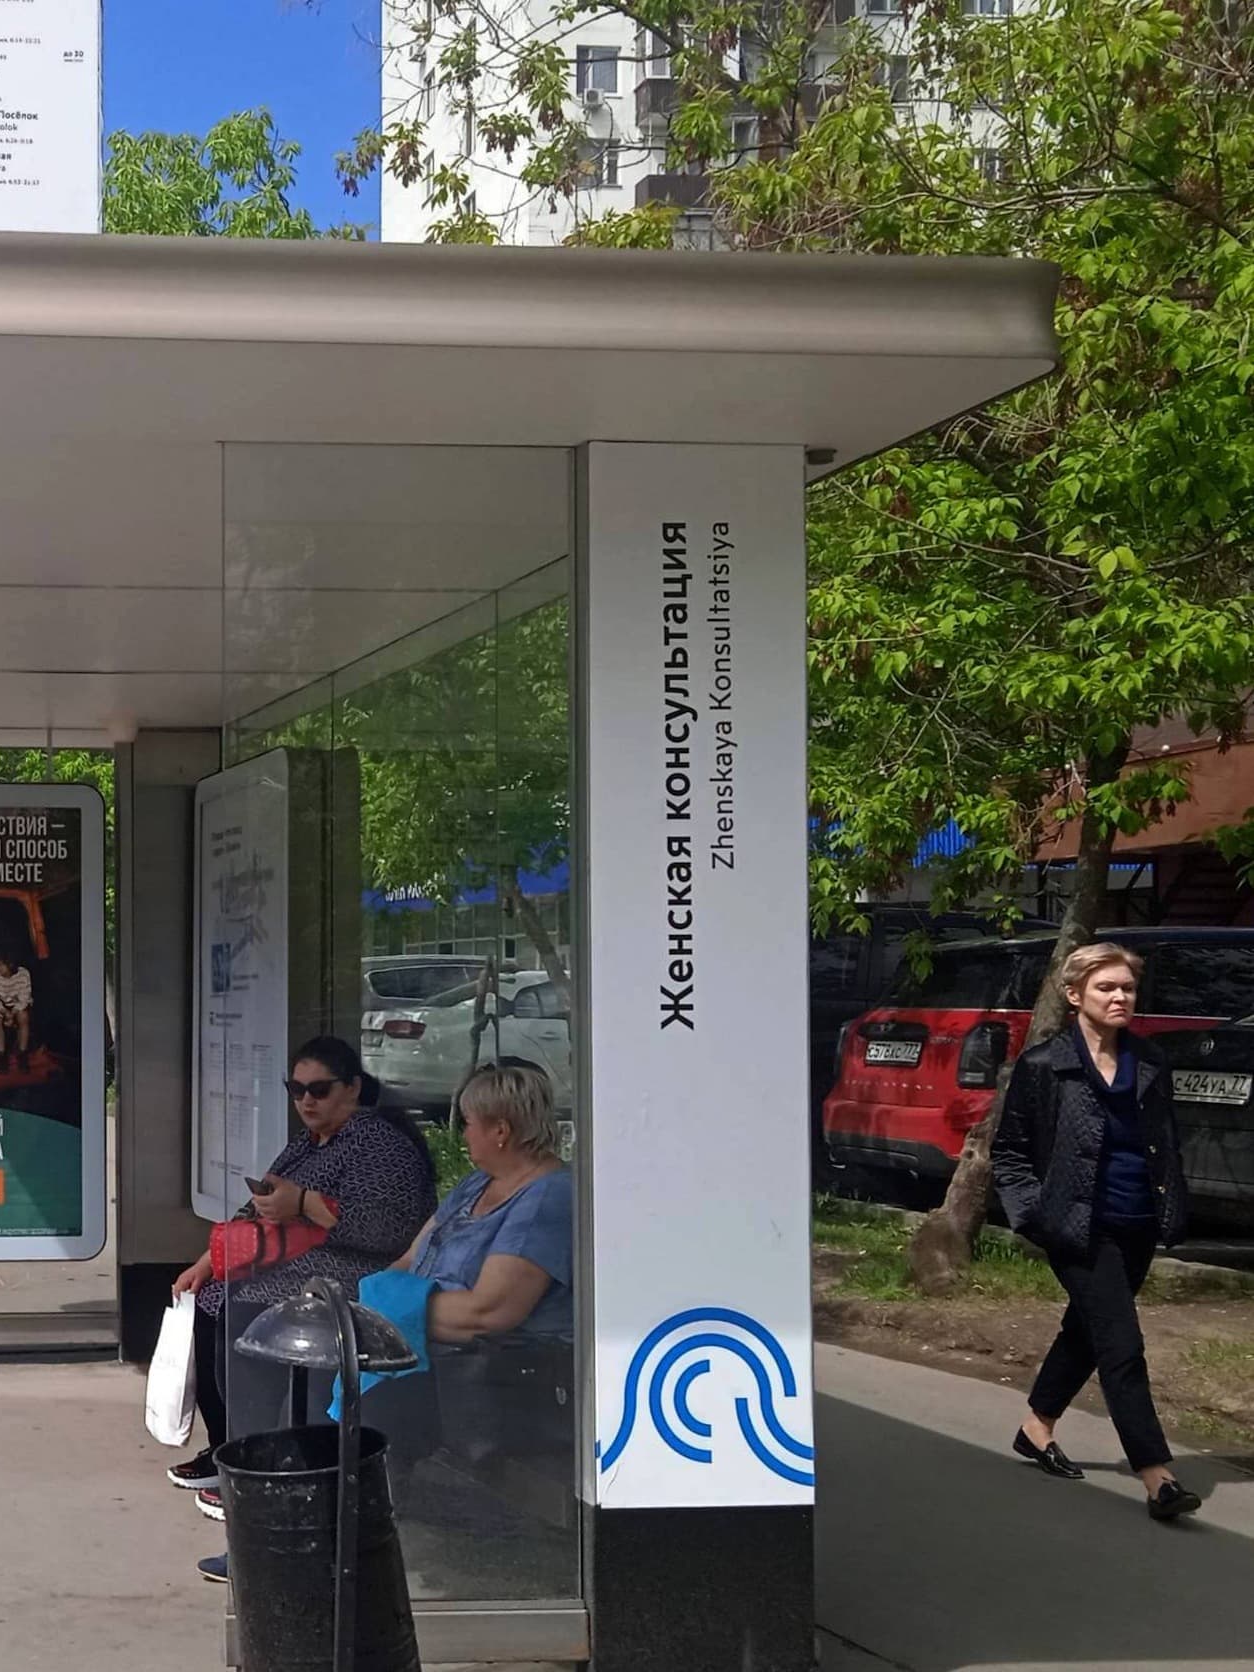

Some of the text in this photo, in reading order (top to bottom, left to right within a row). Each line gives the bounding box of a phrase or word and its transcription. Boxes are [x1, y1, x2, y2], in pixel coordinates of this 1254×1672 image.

[659, 522, 698, 1031] Женская консультация
[706, 522, 738, 869] Zhenskaya Konsultatsiya
[5, 839, 68, 859] СПОСОБ
[1174, 1073, 1247, 1094] С424УА 77
